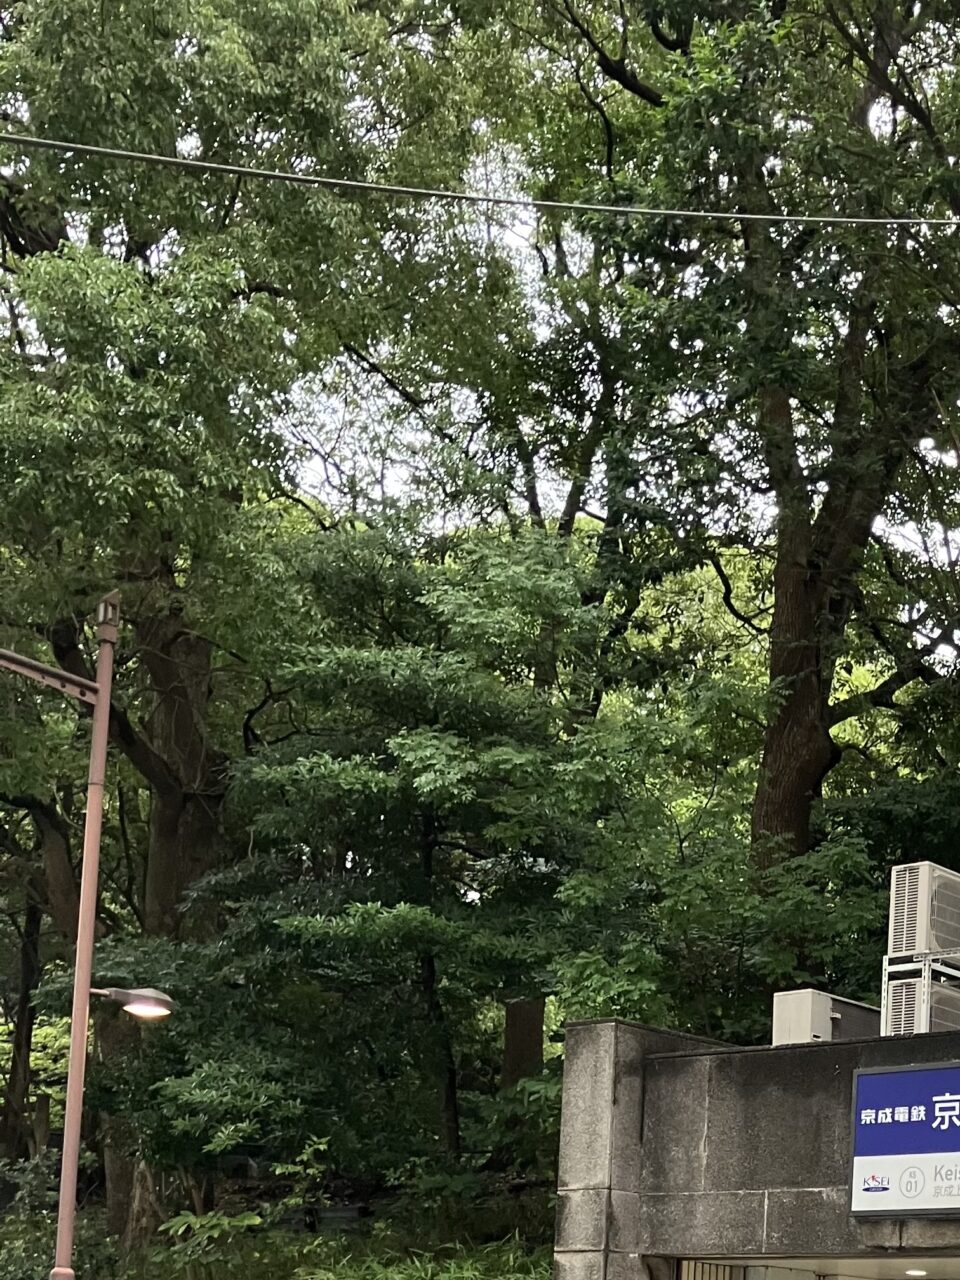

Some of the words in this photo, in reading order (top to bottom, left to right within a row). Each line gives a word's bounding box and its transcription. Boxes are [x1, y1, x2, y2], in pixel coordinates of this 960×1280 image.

[861, 1105, 926, 1124] 京成電鉄
[906, 1181, 918, 1193] 01
